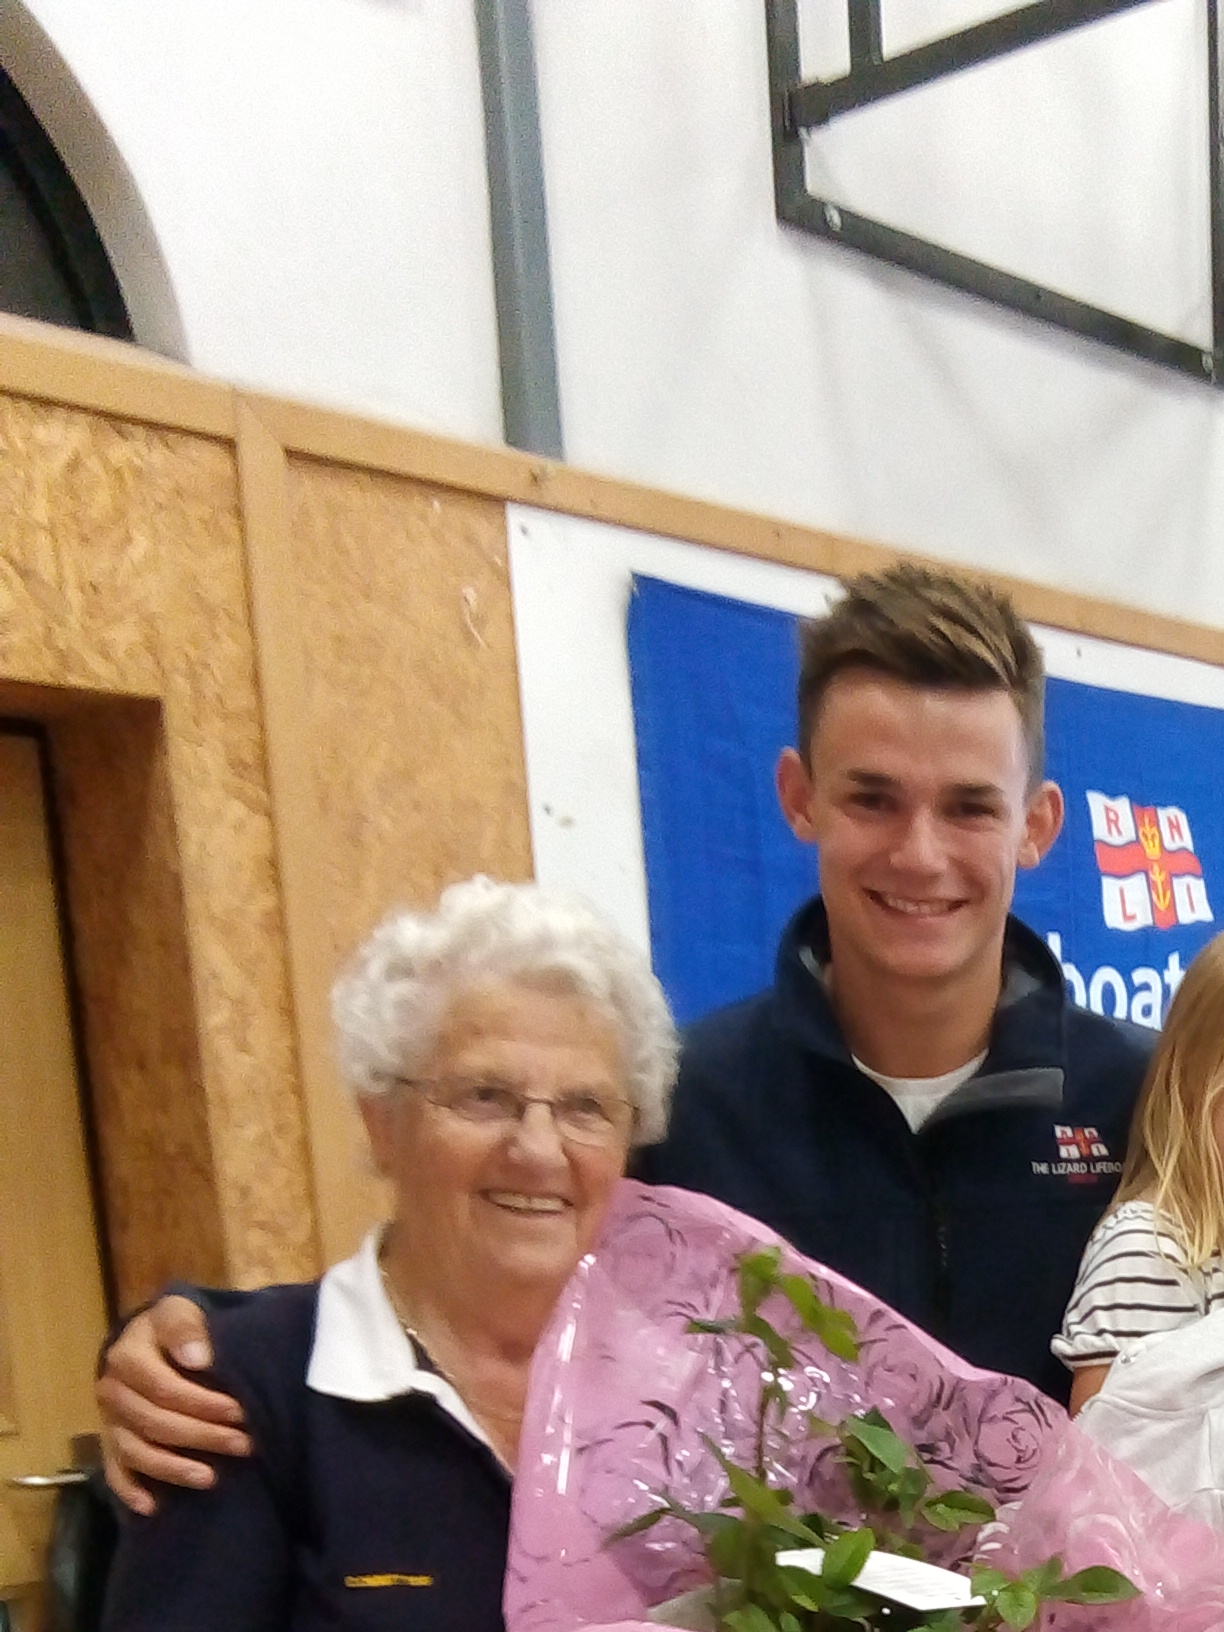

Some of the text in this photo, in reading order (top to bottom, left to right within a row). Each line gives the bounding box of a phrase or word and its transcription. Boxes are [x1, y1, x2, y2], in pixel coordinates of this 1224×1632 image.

[1104, 804, 1186, 844] R N
[1119, 886, 1137, 924] L
[1031, 1161, 1050, 1175] THE
[1051, 1161, 1088, 1175] LIZARD
